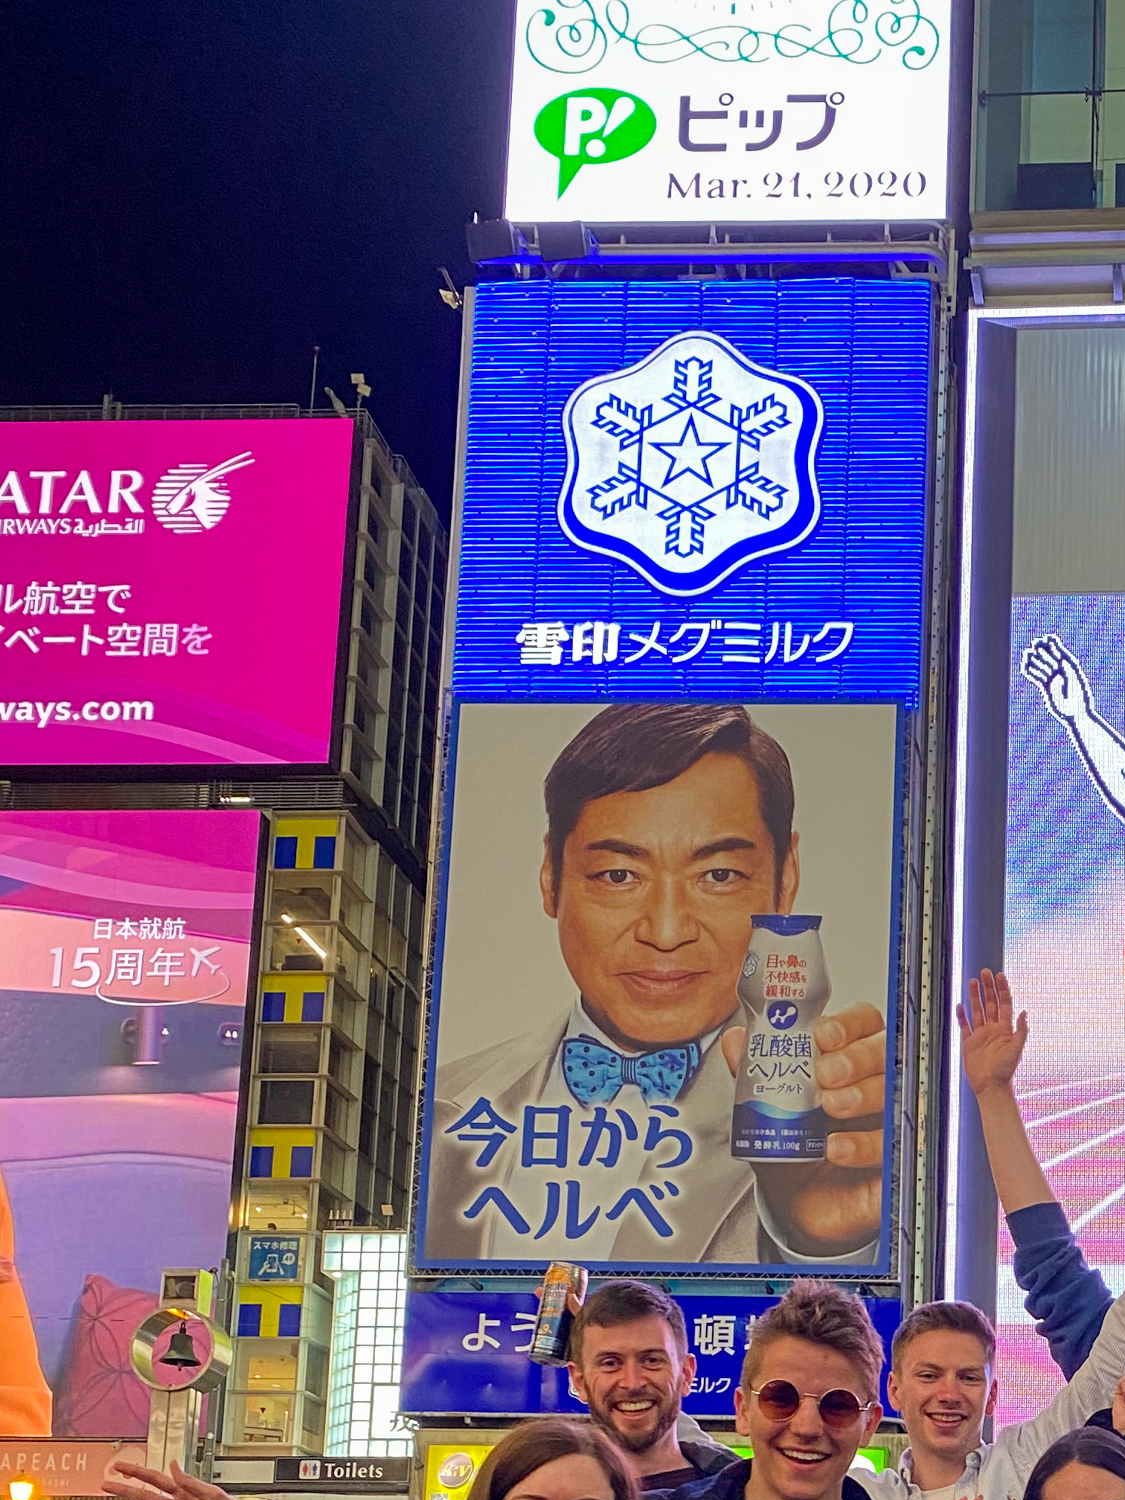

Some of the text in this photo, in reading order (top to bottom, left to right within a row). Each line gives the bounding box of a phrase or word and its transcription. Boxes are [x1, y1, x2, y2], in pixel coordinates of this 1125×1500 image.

[678, 92, 845, 152] ピップ
[667, 170, 928, 200] Mar. 21, 2020
[0, 622, 213, 657] ベート空間を
[515, 619, 856, 666] 雪印メグミルク
[93, 917, 186, 940] 日本就航
[49, 947, 187, 989] 15周年
[766, 954, 807, 968] 目や鼻の
[765, 970, 807, 983] 不快感を
[765, 985, 805, 998] 緩和する
[749, 1033, 812, 1058] 乳酸菌
[749, 1060, 811, 1082] ヘルベ
[755, 1083, 803, 1094] ヨーグルト
[445, 1096, 694, 1170] 今日から
[462, 1180, 680, 1241] ヘルベ
[253, 1240, 298, 1251] スマホ修理
[325, 1462, 384, 1480] Toilets
